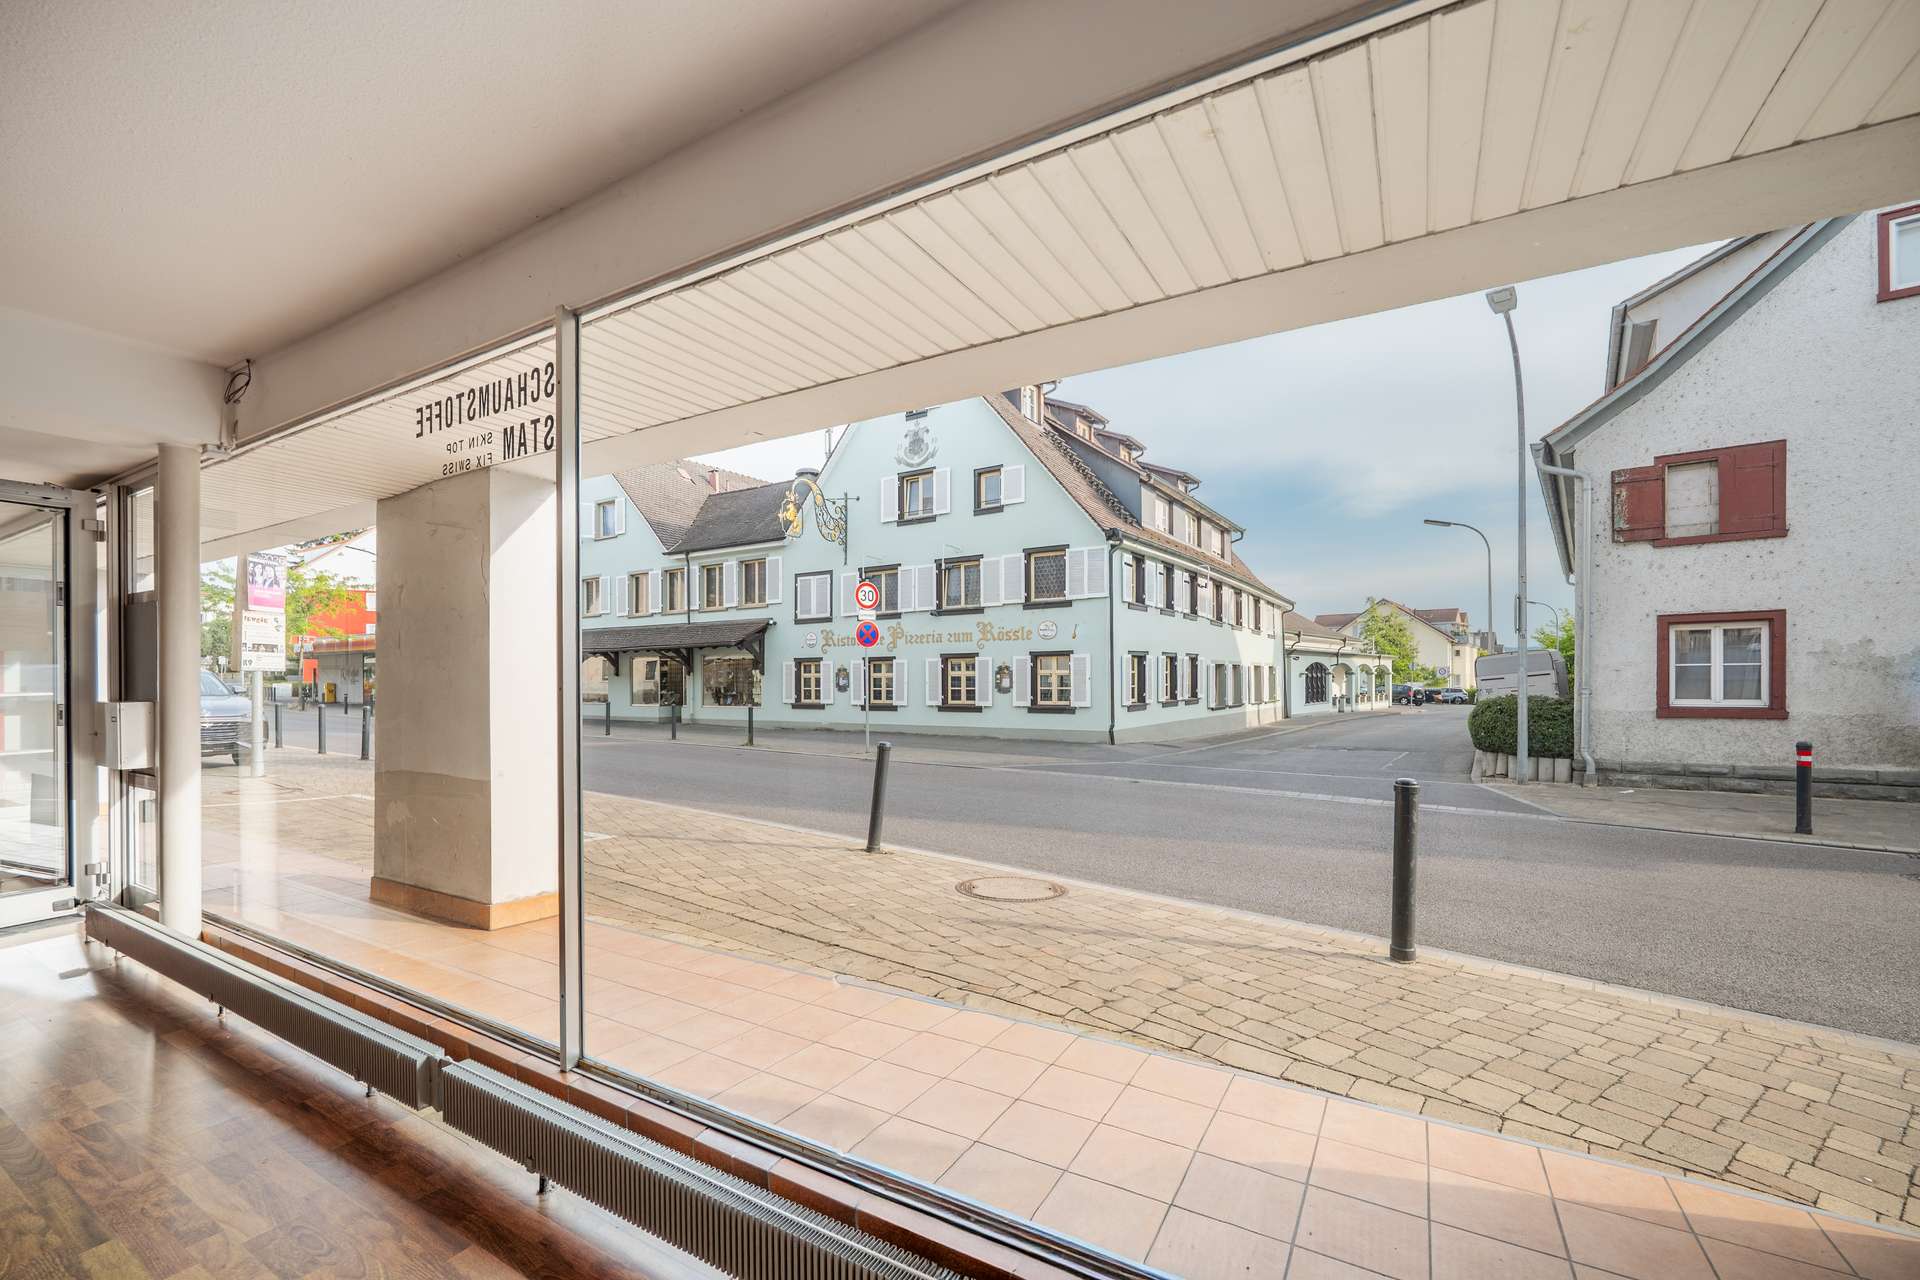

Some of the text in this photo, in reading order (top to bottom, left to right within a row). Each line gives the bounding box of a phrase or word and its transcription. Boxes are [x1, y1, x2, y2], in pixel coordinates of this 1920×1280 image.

[860, 589, 874, 602] 30
[821, 628, 885, 655] Ristoe
[886, 621, 943, 652] Pizzeria
[947, 630, 973, 643] zum
[976, 621, 1033, 650] Rössle
